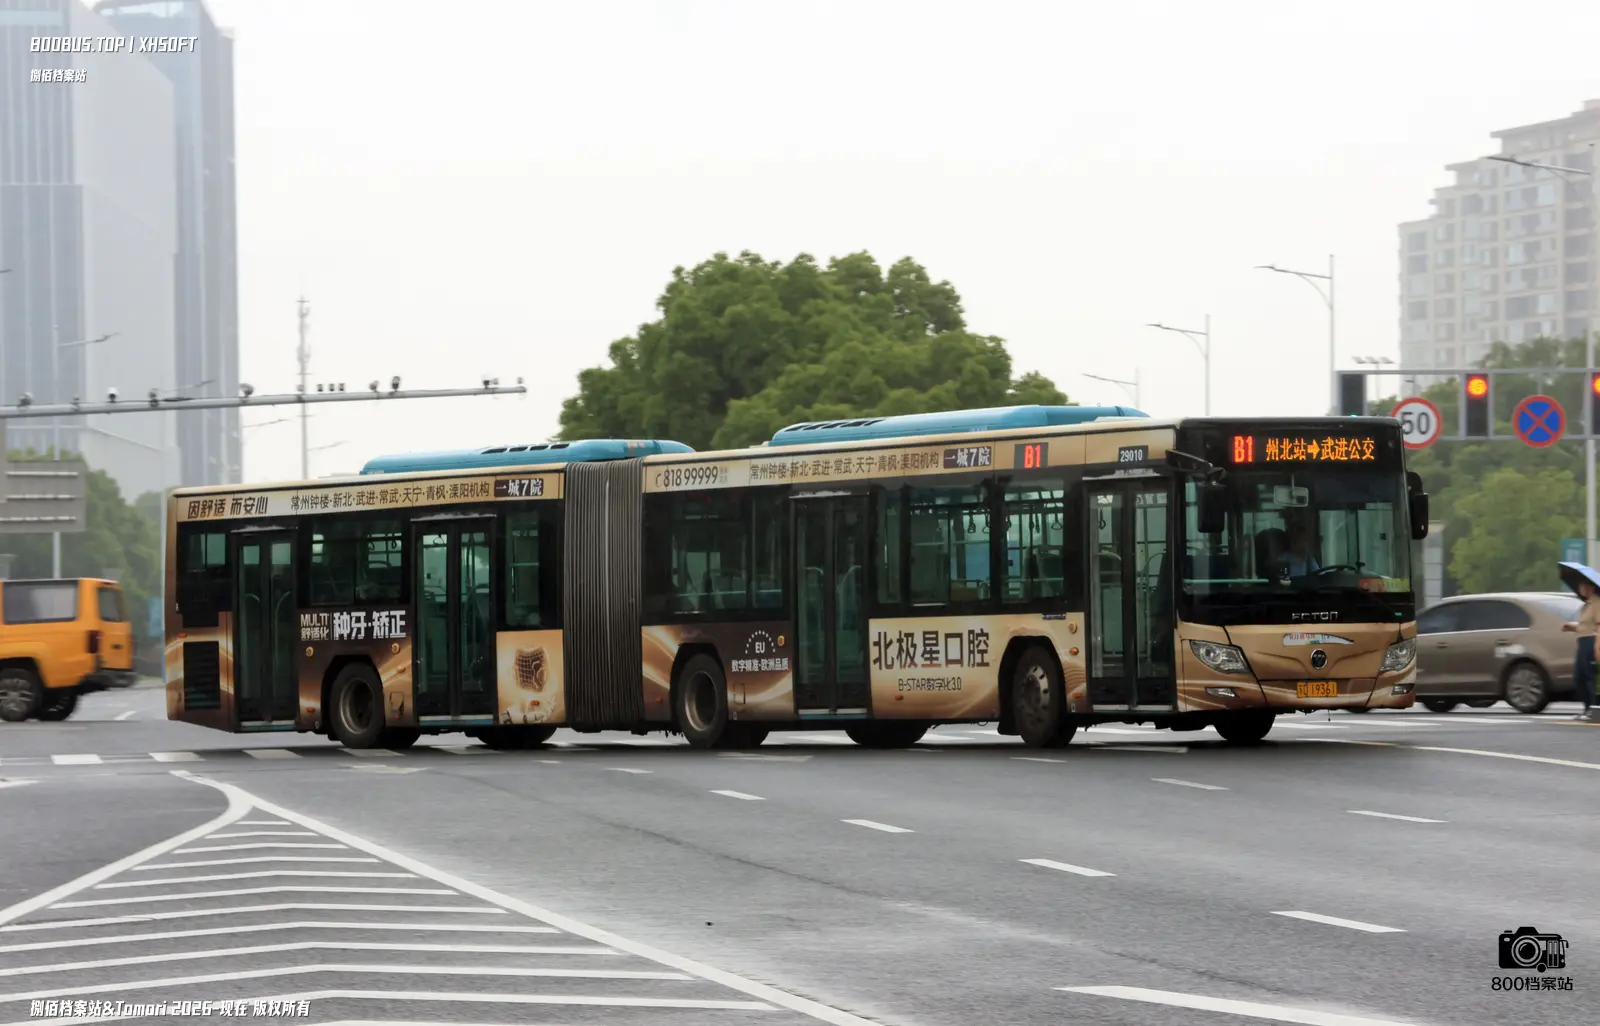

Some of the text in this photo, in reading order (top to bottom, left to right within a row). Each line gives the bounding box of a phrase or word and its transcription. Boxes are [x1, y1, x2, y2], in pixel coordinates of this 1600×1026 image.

[1401, 411, 1430, 435] 50
[1024, 445, 1041, 469] B1
[1120, 449, 1143, 463] 29010
[1234, 435, 1253, 463] B1
[755, 641, 766, 654] EU
[873, 628, 990, 670] 北极星口腔
